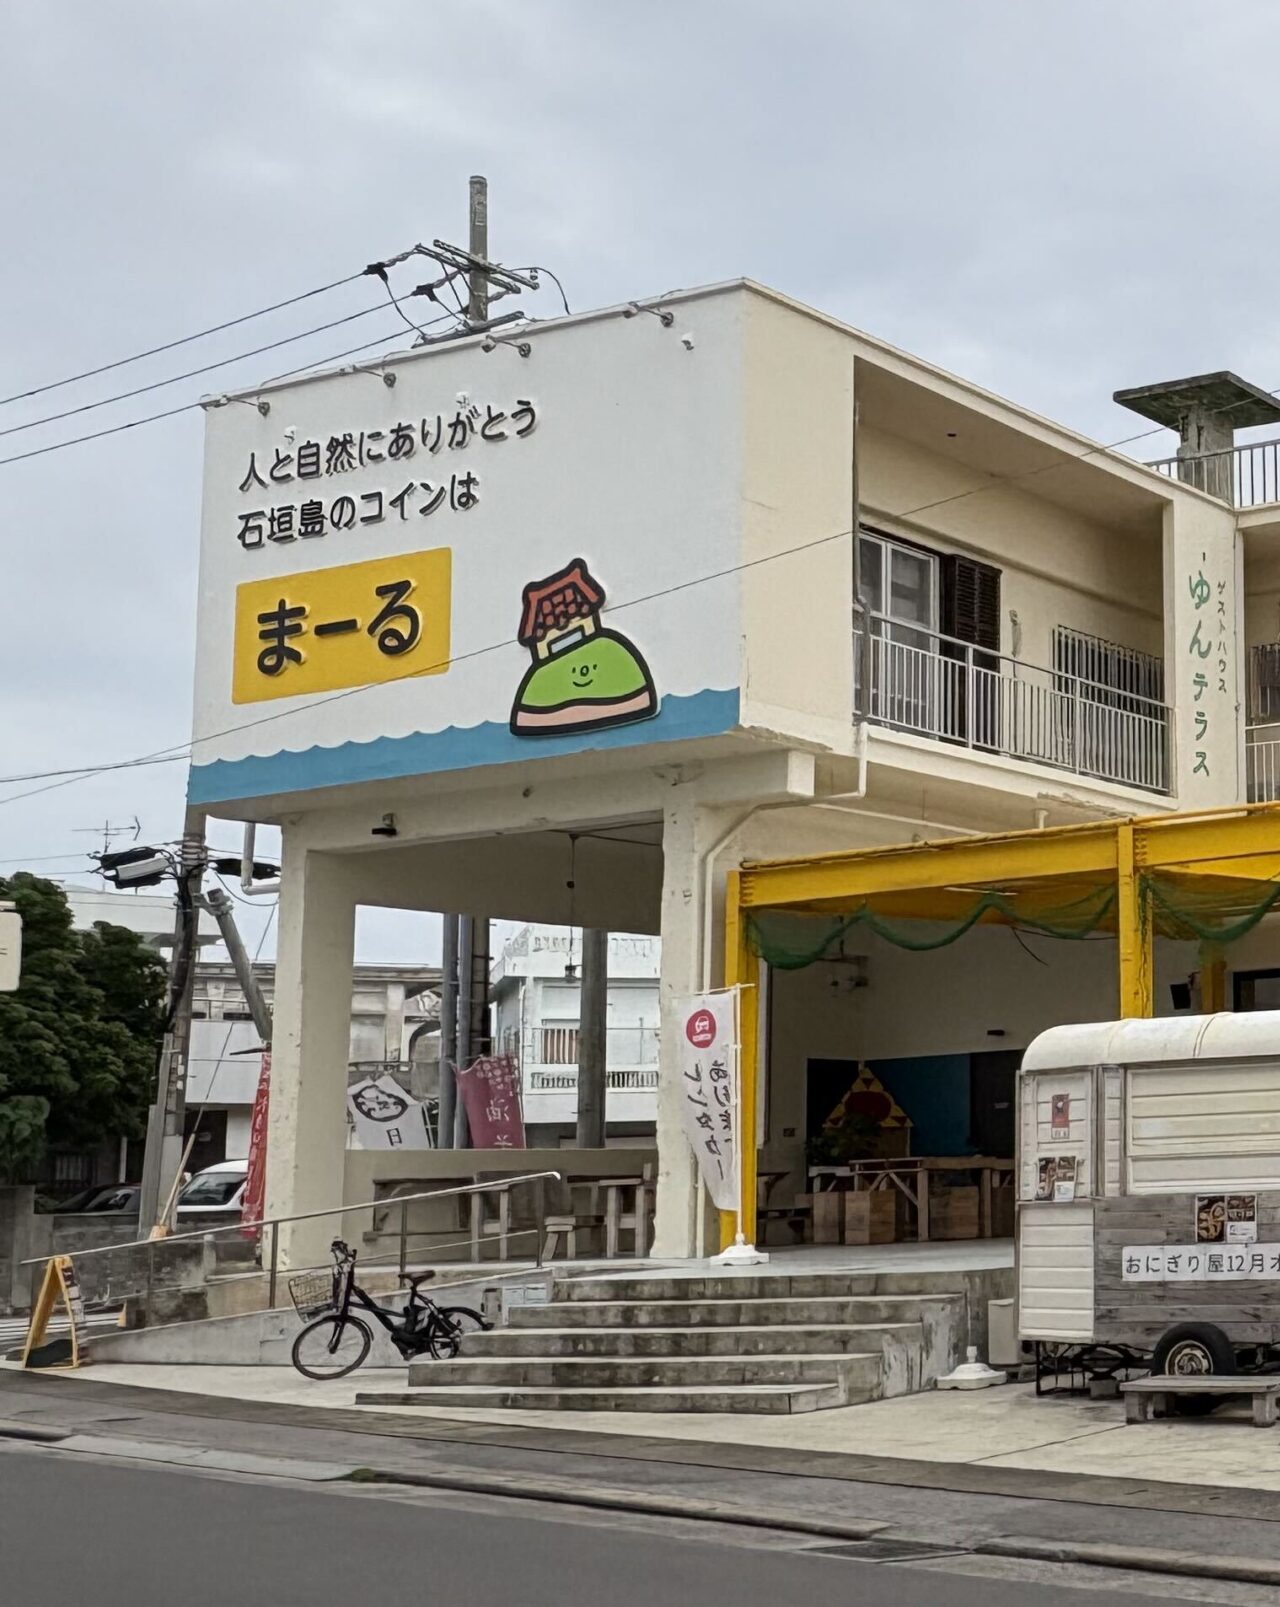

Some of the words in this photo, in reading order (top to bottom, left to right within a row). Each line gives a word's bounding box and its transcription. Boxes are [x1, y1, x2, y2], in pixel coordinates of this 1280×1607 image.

[238, 399, 538, 492] 人と自然にありがとう
[236, 471, 479, 549] 石垣島のコインは
[256, 579, 424, 676] まーる
[1189, 570, 1212, 777] ゆんテラス
[1217, 580, 1227, 693] ゲストハウス
